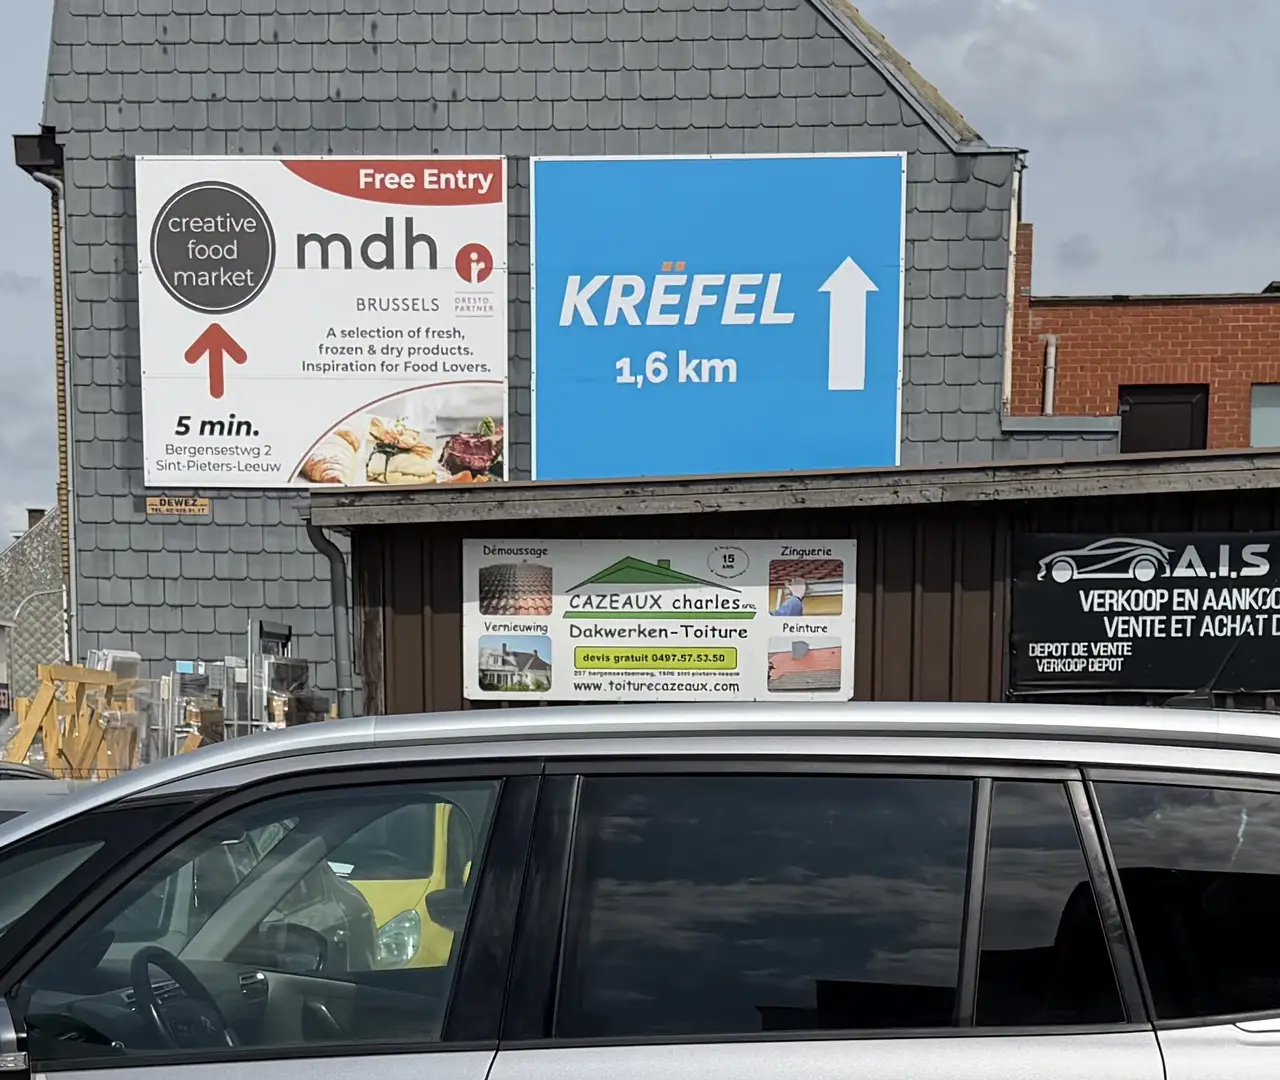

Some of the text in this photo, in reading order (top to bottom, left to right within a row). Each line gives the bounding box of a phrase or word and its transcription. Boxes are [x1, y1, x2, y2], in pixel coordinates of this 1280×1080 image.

[359, 169, 494, 194] Free Entry
[169, 213, 257, 233] creative
[187, 240, 239, 260] food
[297, 217, 438, 270] mdh
[174, 268, 255, 287] market
[559, 261, 795, 326] KRËFEL
[356, 298, 440, 312] BRUSSELS
[326, 326, 466, 342] A selection of fresh,
[318, 343, 474, 358] frozen & dry products.
[302, 360, 492, 375] Inspiration for Food Lovers.
[615, 350, 737, 389] 1,6 km
[175, 414, 260, 437] 5 min.
[165, 444, 272, 459] Bergensestwg 2
[156, 459, 282, 472] Sint-Pieters-Leeuw
[159, 499, 198, 507] DEWEZ
[483, 545, 549, 557] Démoussage
[722, 554, 735, 563] 15
[780, 546, 832, 558] Zinguerie
[1172, 544, 1271, 579] A.I.S
[569, 594, 662, 610] CAZEAUX
[672, 594, 740, 610] charles
[1079, 588, 1169, 612] VERKOOP
[1173, 588, 1200, 611] EN
[484, 622, 549, 635] Vernieuwing
[569, 624, 748, 639] Dakwerken-Toiture
[782, 623, 828, 634] Peinture
[1104, 615, 1166, 638] VENTE
[1170, 615, 1195, 637] ET
[1200, 614, 1268, 637] ACHAT
[1029, 642, 1133, 657] DEPOT DE VENTE
[583, 654, 610, 662] devis
[614, 654, 648, 663] gratuit
[1036, 657, 1125, 672] VERKOOP DEPOT
[574, 680, 740, 693] www.toiturecazeaux.com
